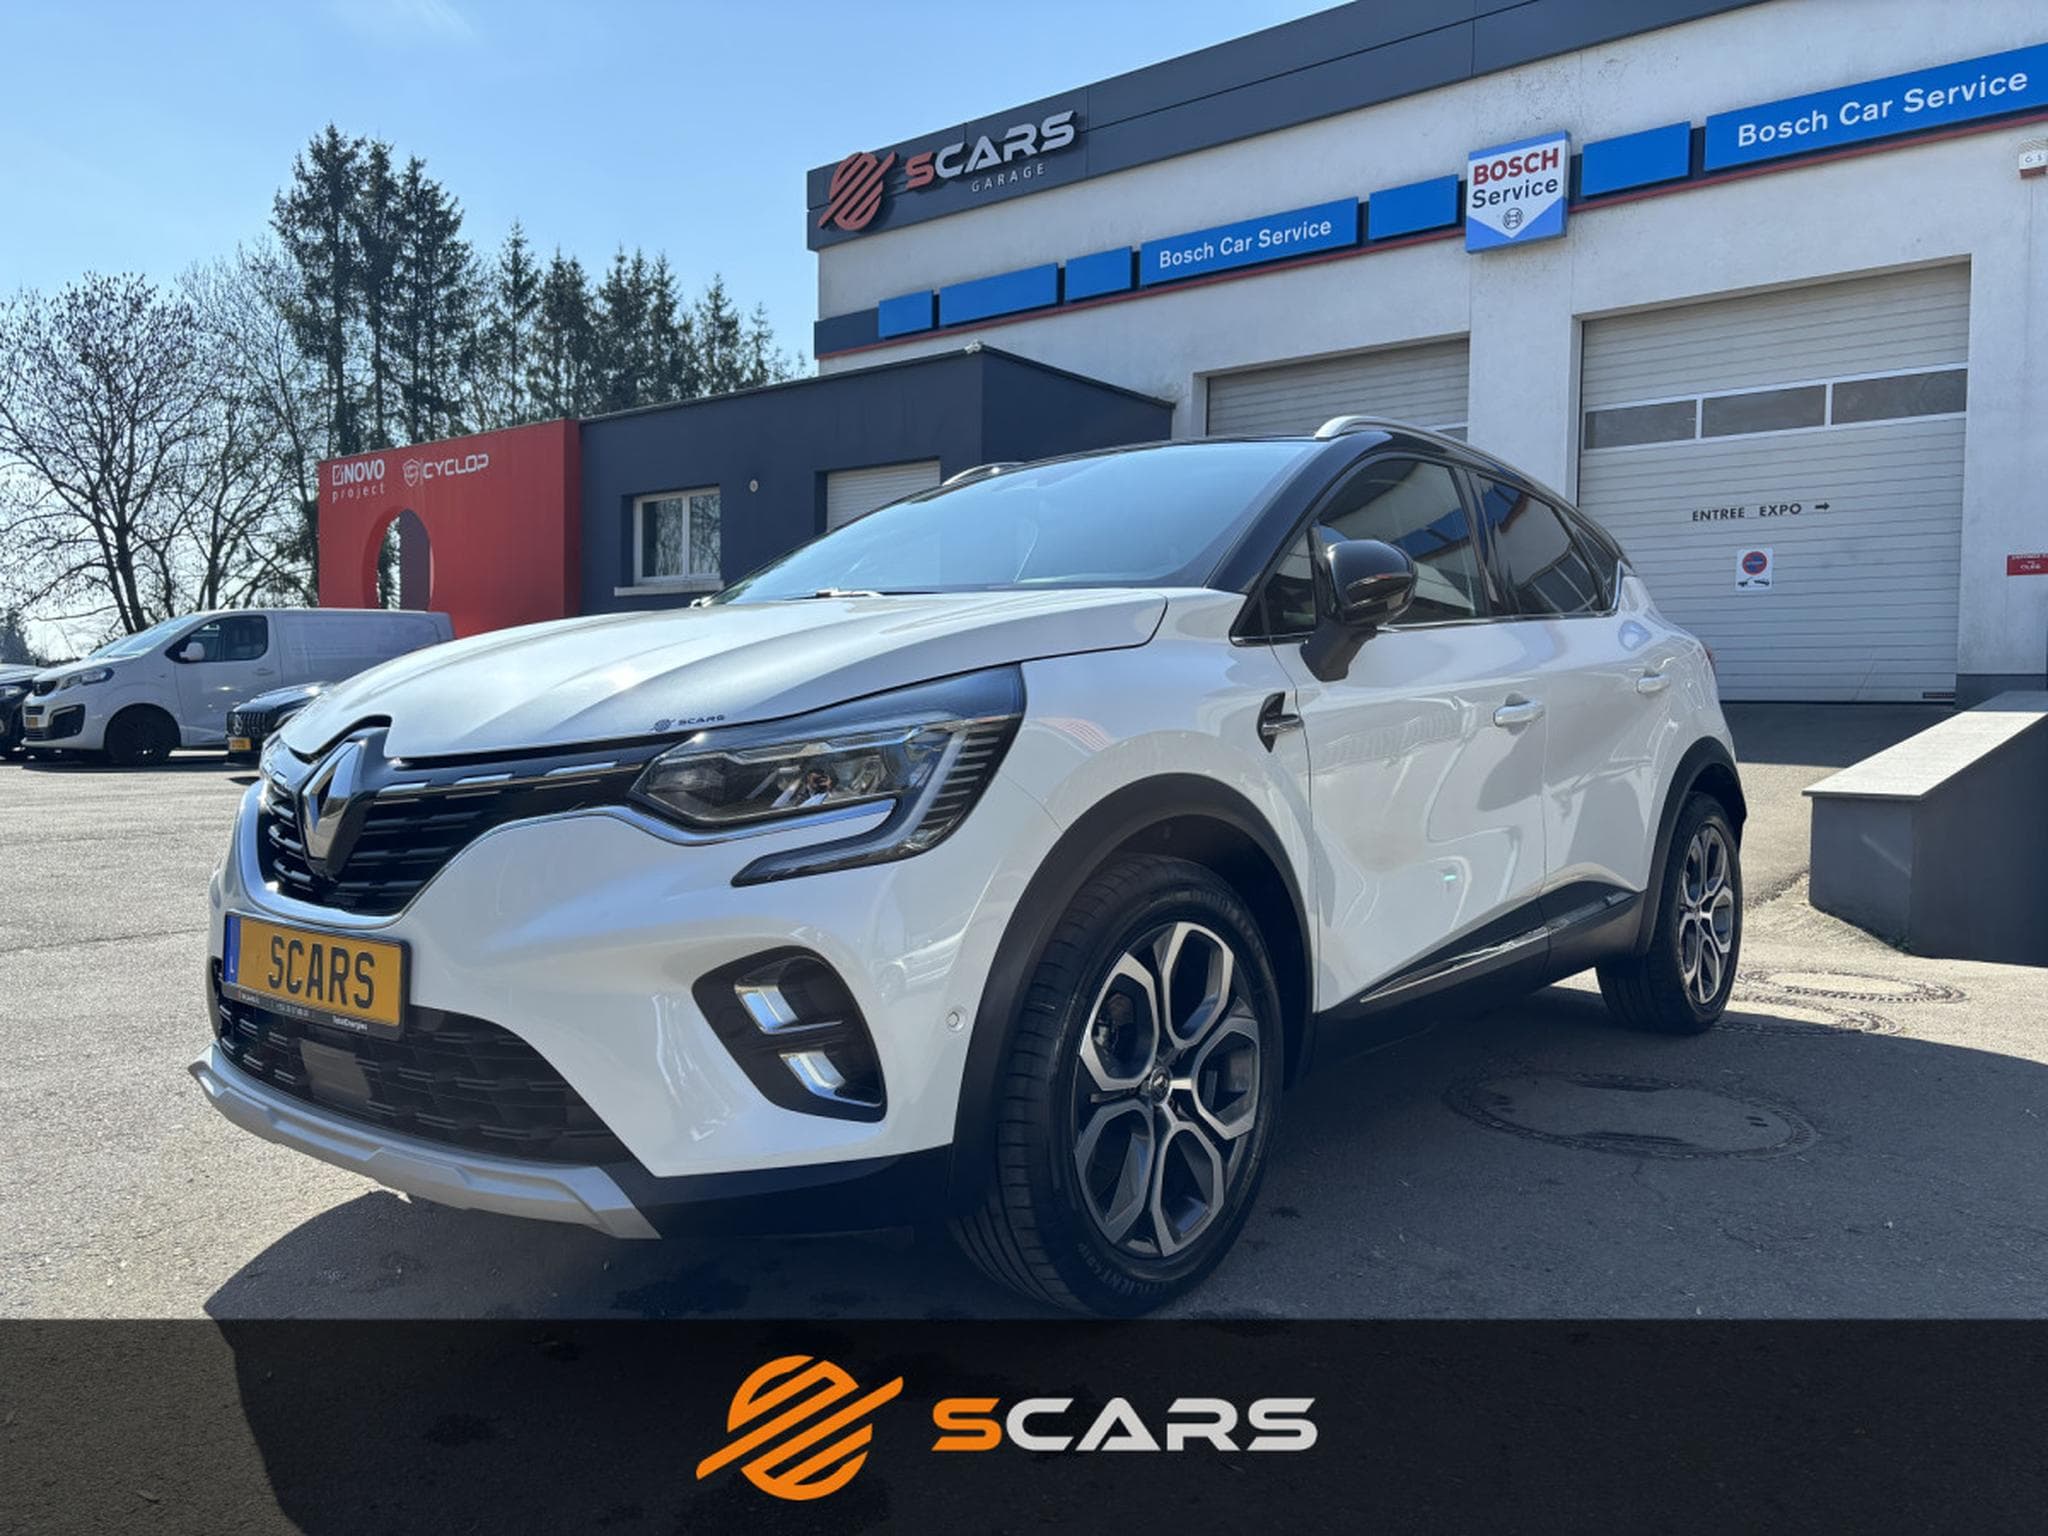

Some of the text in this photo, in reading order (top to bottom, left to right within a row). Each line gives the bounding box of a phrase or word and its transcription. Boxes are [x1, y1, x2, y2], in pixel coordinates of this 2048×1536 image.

[1737, 72, 2028, 147] Bosch Car Service
[971, 162, 1045, 193] GARAGE
[1473, 147, 1559, 186] BOSCH
[1472, 178, 1558, 209] Service
[1159, 220, 1332, 269] Bosch Car Service
[332, 482, 385, 504] project
[1692, 503, 1802, 522] ENTREE EXPO
[267, 934, 375, 1009] SCARS
